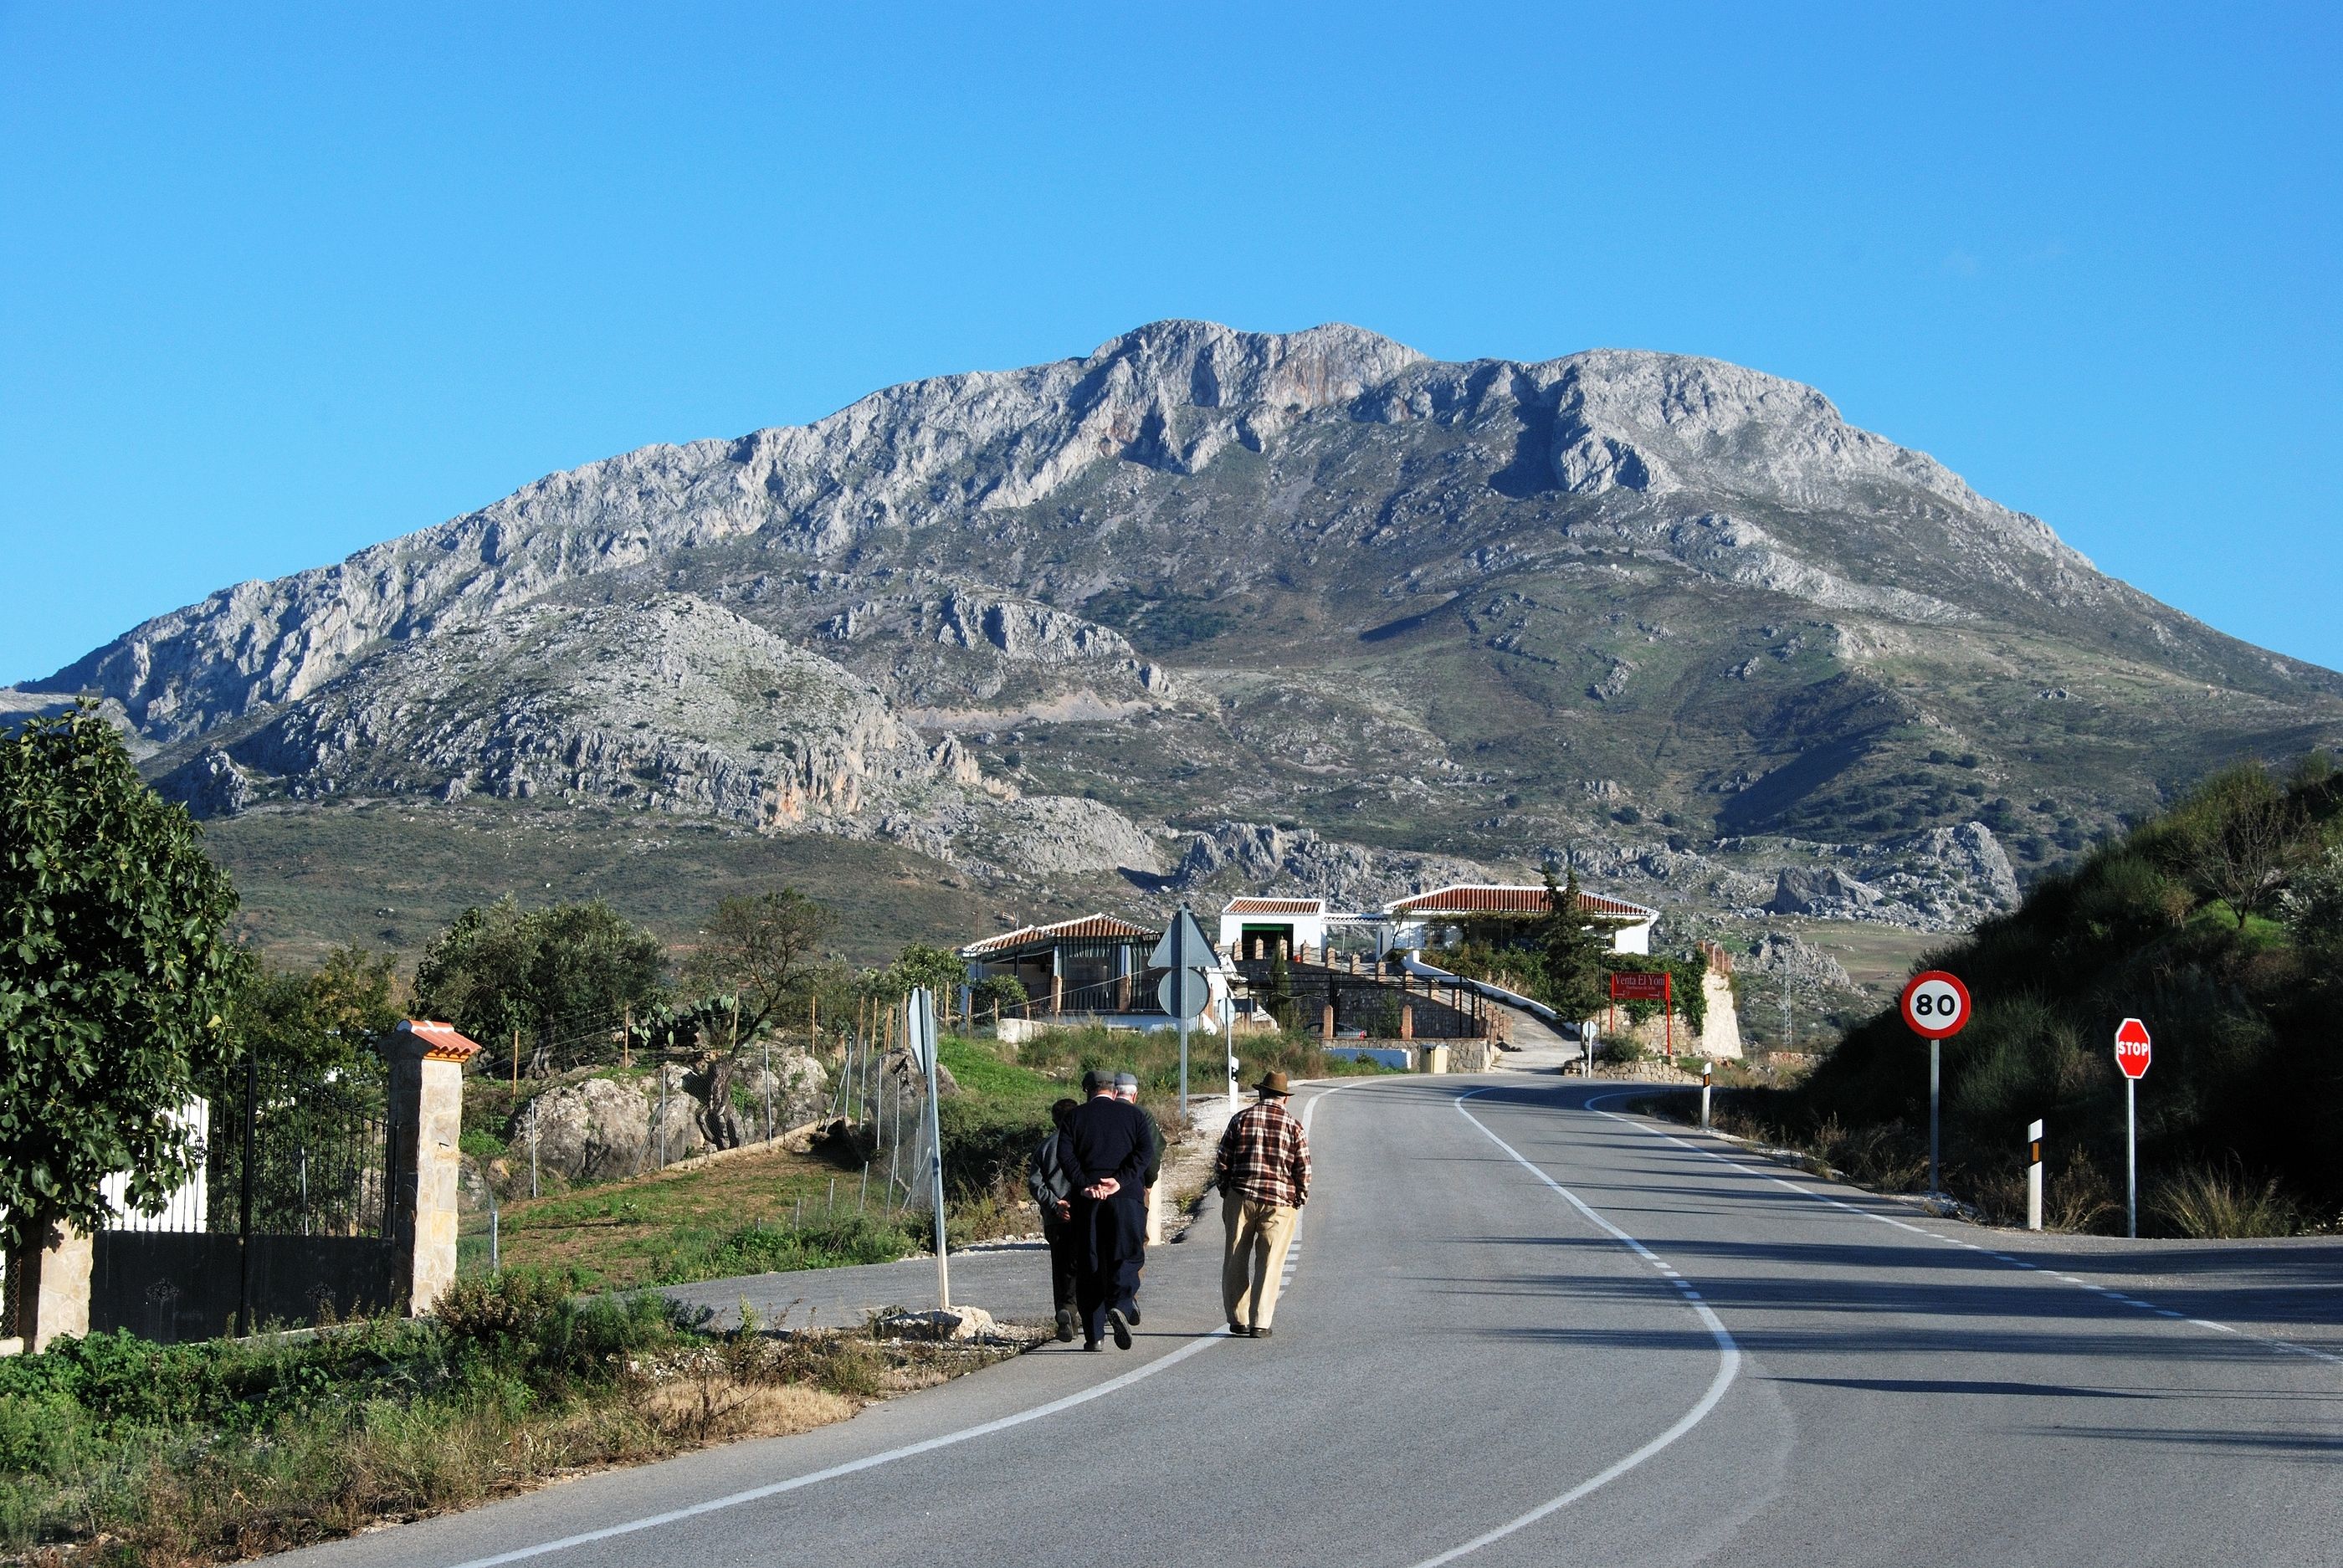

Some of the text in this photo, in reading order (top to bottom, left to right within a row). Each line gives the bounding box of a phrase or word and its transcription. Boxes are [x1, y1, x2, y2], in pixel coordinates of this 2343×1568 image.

[1615, 974, 1665, 986] Venta El Yoni
[1916, 993, 1955, 1017] 80
[2119, 1041, 2149, 1057] STOP
